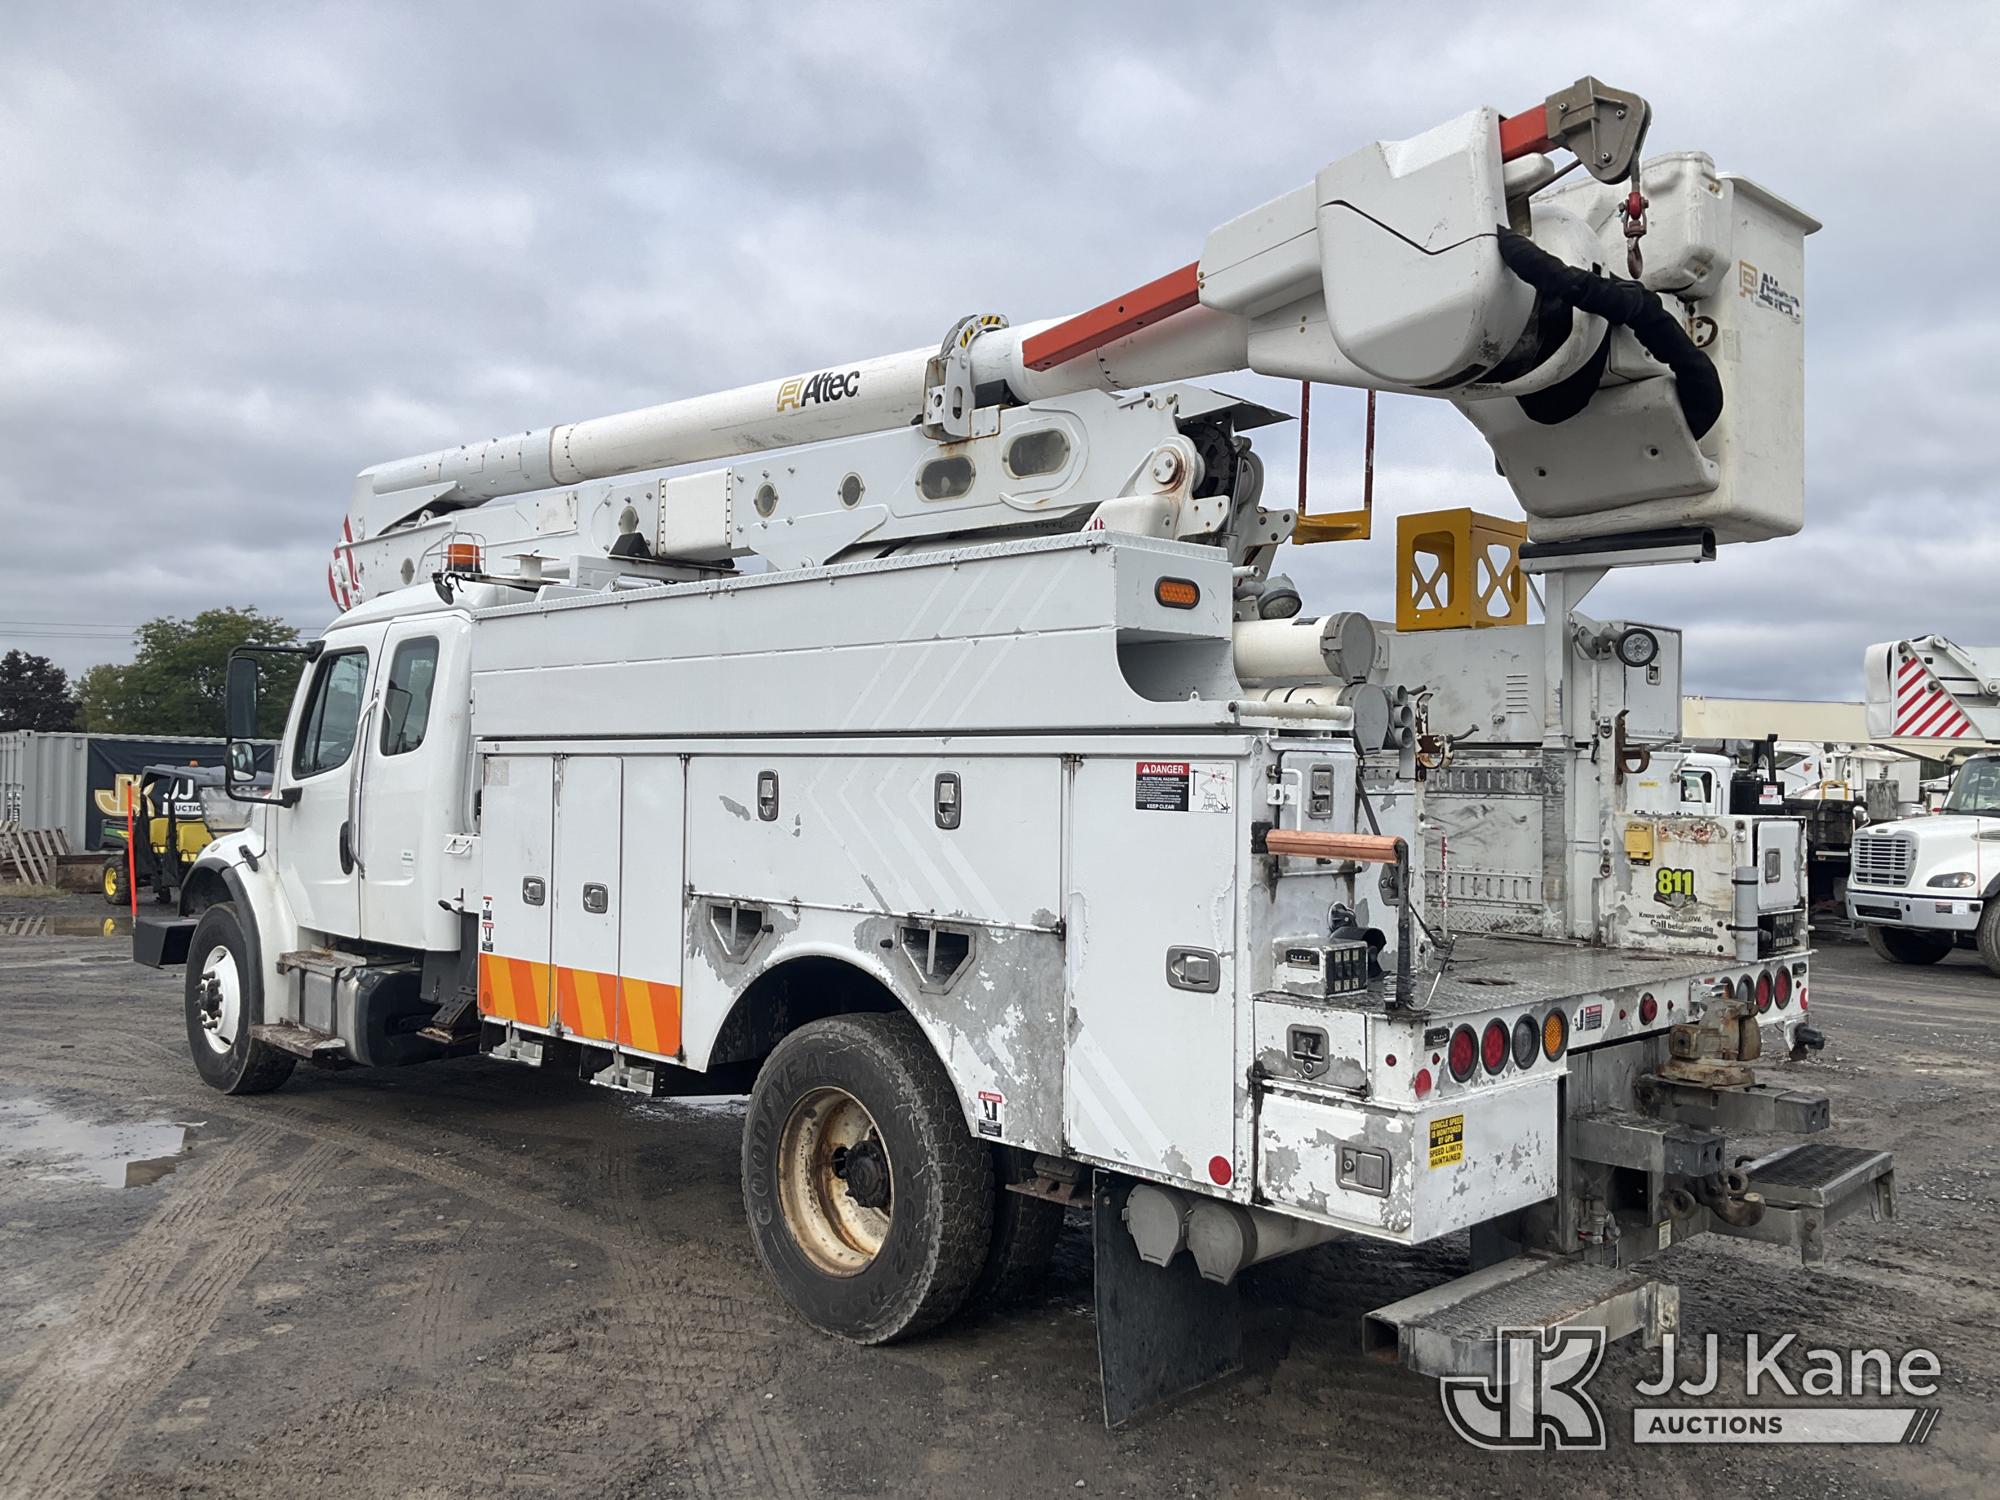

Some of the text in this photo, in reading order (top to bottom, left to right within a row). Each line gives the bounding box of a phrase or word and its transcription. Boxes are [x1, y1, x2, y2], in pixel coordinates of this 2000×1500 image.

[801, 371, 860, 407] Altec
[1150, 764, 1184, 774] DANGER
[1657, 868, 1693, 896] 811
[1449, 1116, 1463, 1125] SPEED
[1444, 1134, 1454, 1143] GPS
[1430, 1143, 1463, 1158] SPEED LIMITS
[1430, 1152, 1462, 1167] MAINTAINED
